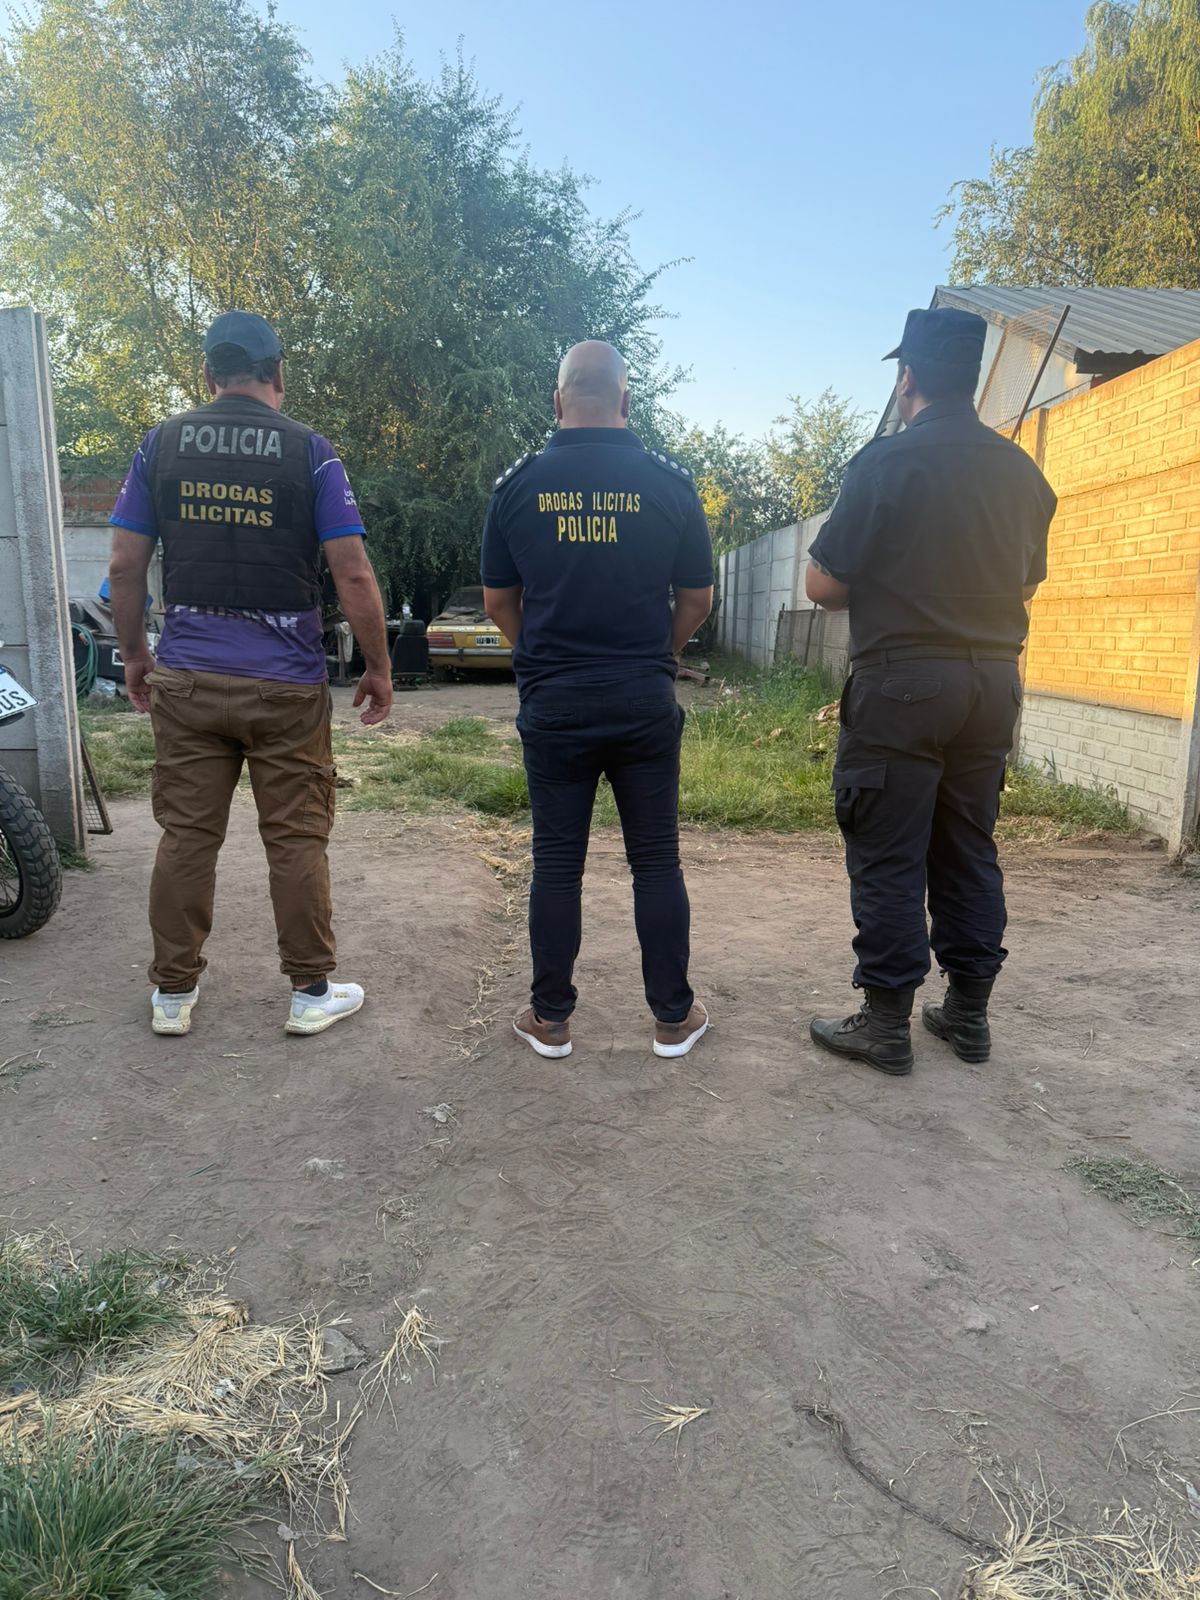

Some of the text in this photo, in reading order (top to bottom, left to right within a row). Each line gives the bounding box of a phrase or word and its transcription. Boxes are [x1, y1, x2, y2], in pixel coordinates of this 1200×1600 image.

[179, 425, 282, 458] POLICIA
[180, 480, 273, 505] DROGAS
[538, 491, 641, 513] DROGAS ILICITAS
[180, 503, 273, 527] ILICITAS
[557, 516, 618, 543] POLICIA
